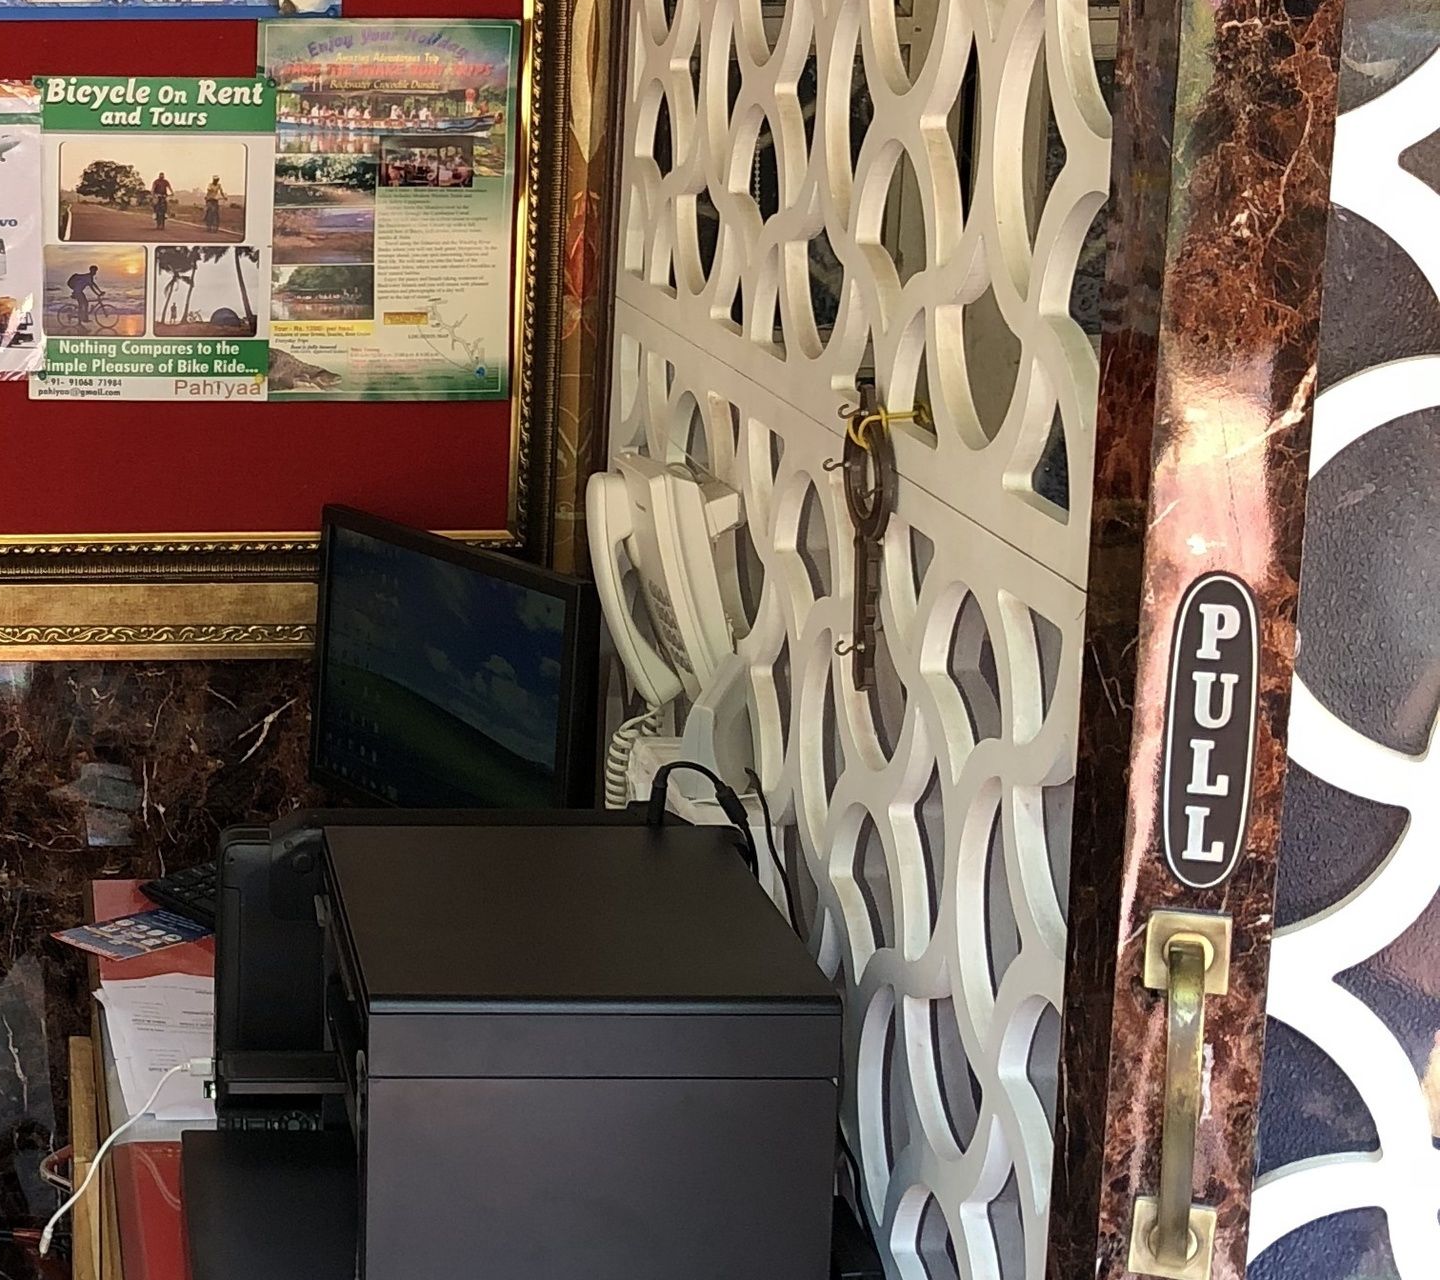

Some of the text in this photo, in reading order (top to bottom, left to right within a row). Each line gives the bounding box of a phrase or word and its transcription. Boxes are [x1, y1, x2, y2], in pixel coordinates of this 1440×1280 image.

[307, 35, 353, 58] Enjoy
[45, 77, 264, 111] Bicycle On Rent
[100, 106, 208, 127] and Tours
[59, 341, 240, 358] Nothing Compares to the
[91, 359, 154, 374] Pleasure
[158, 358, 174, 374] of
[177, 359, 209, 374] Bike
[213, 359, 259, 374] Ride...
[1182, 602, 1241, 864] PULL
